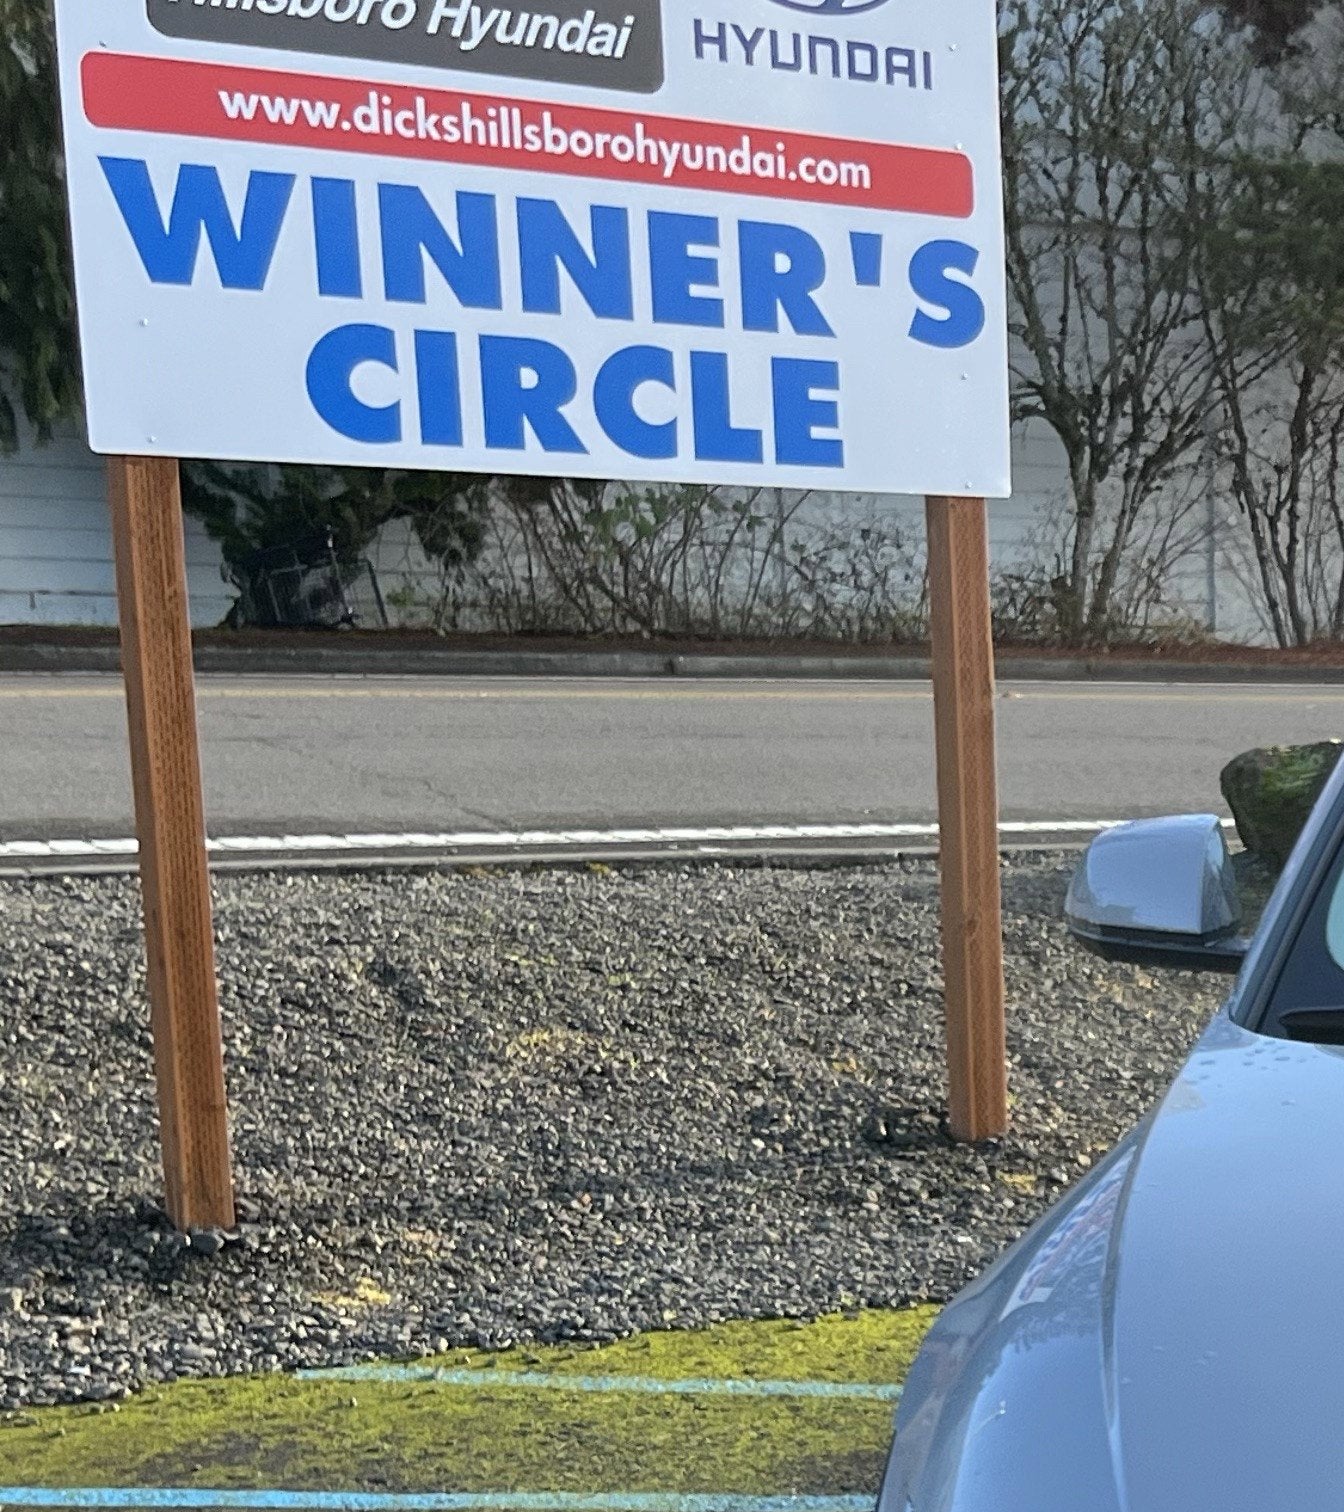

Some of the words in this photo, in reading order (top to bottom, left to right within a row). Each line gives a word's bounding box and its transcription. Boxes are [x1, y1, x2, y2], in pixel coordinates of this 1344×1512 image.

[167, 0, 418, 29] sboro
[427, 0, 635, 59] Hyundai
[693, 18, 933, 91] HYUNDAI
[219, 87, 872, 191] www.dickshillsborohyundai.com
[97, 156, 986, 349] WINNER'S
[305, 322, 845, 469] CIRCLE
